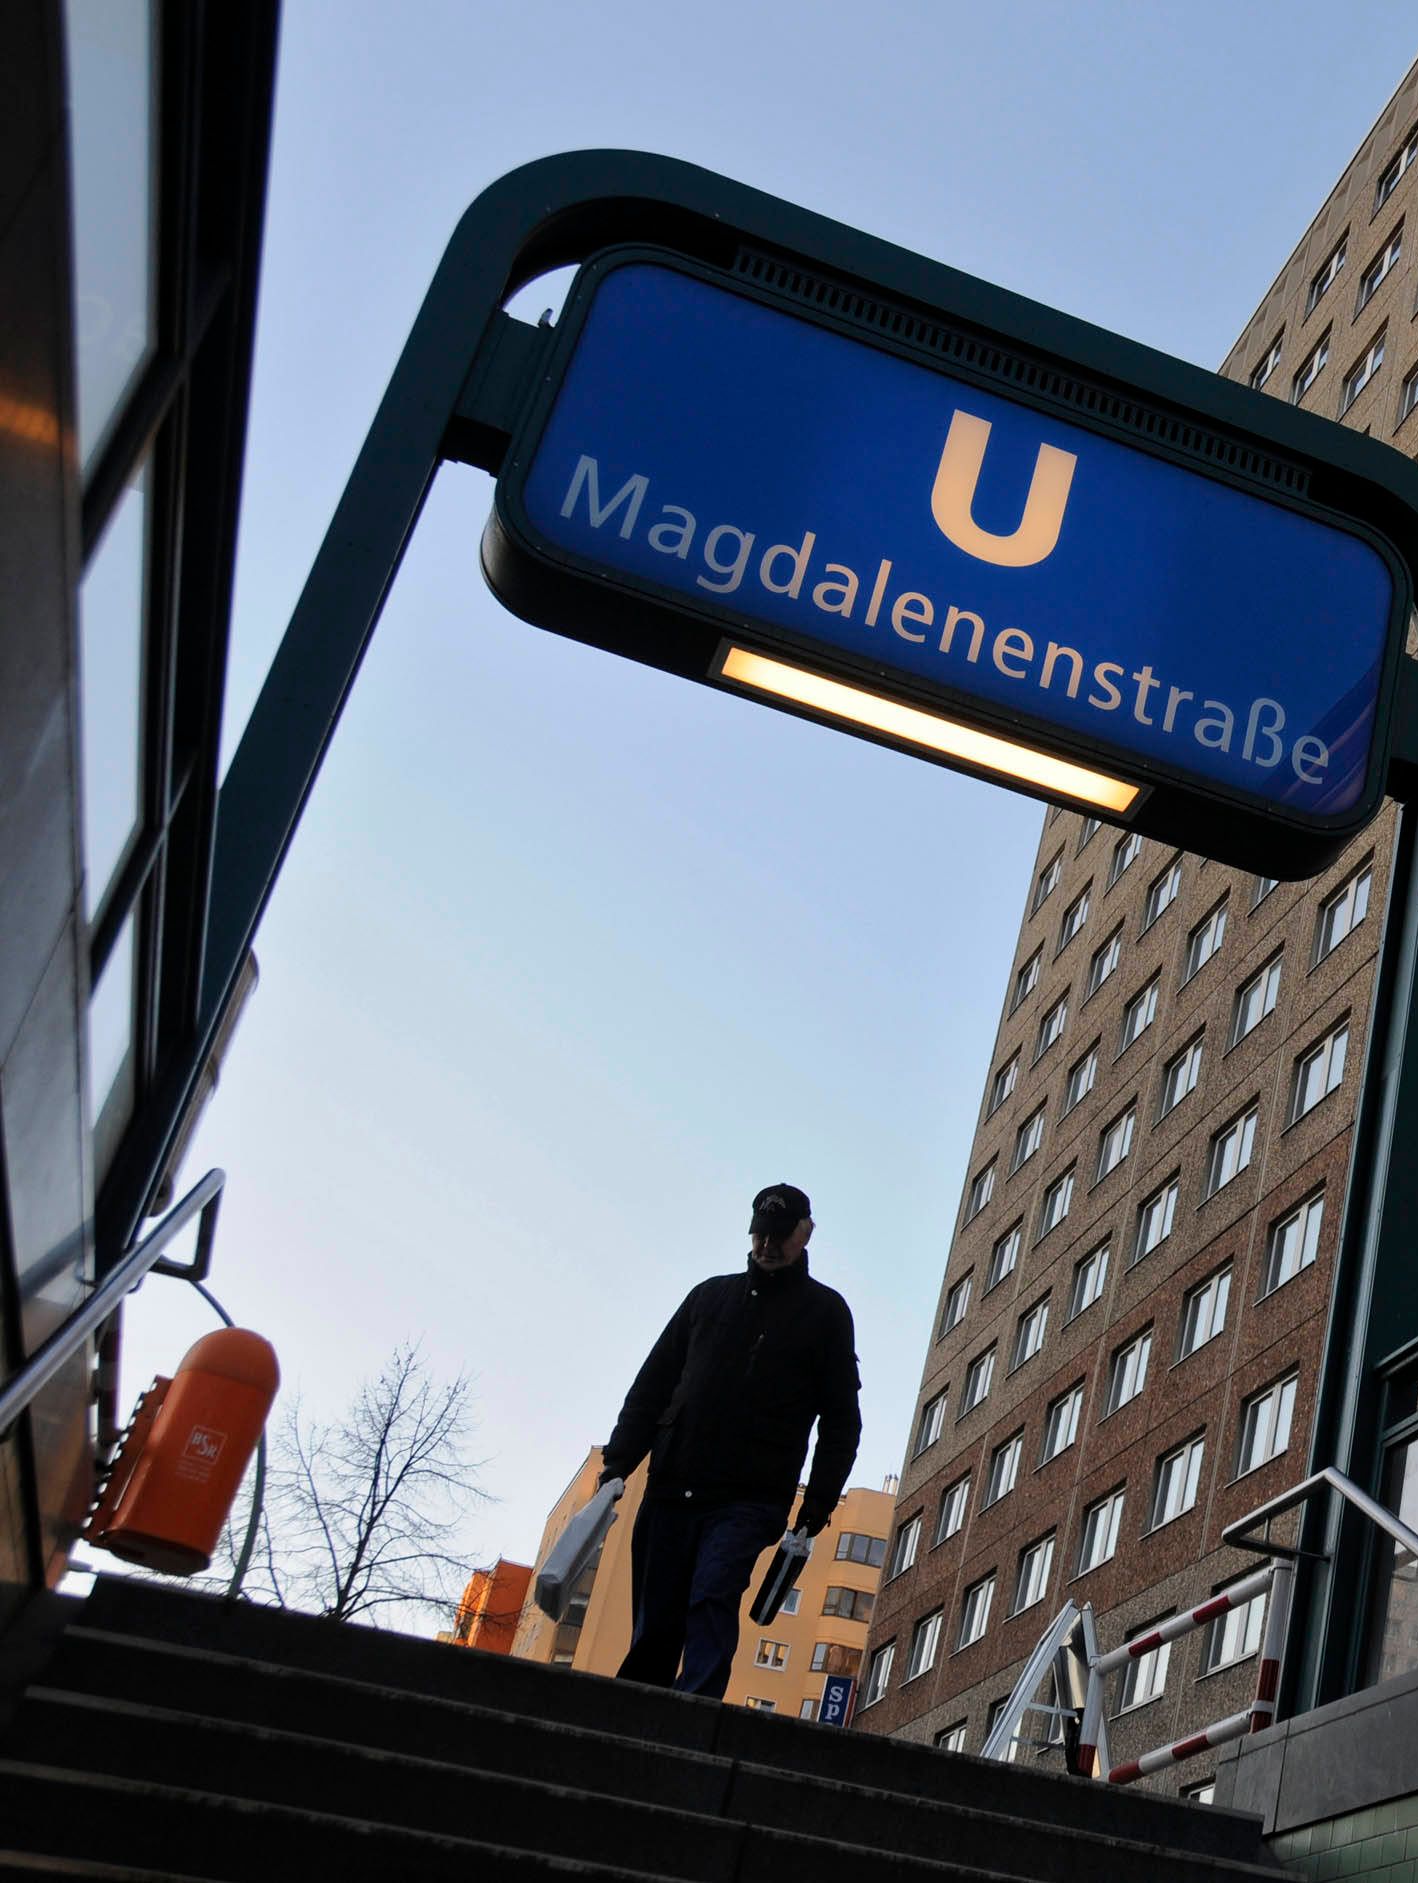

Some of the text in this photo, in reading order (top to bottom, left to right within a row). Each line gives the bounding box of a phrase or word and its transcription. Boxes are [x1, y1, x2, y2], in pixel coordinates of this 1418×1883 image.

[930, 409, 1078, 568] U
[559, 453, 1331, 786] Magdalenenstraße
[824, 1685, 844, 1725] Sp
